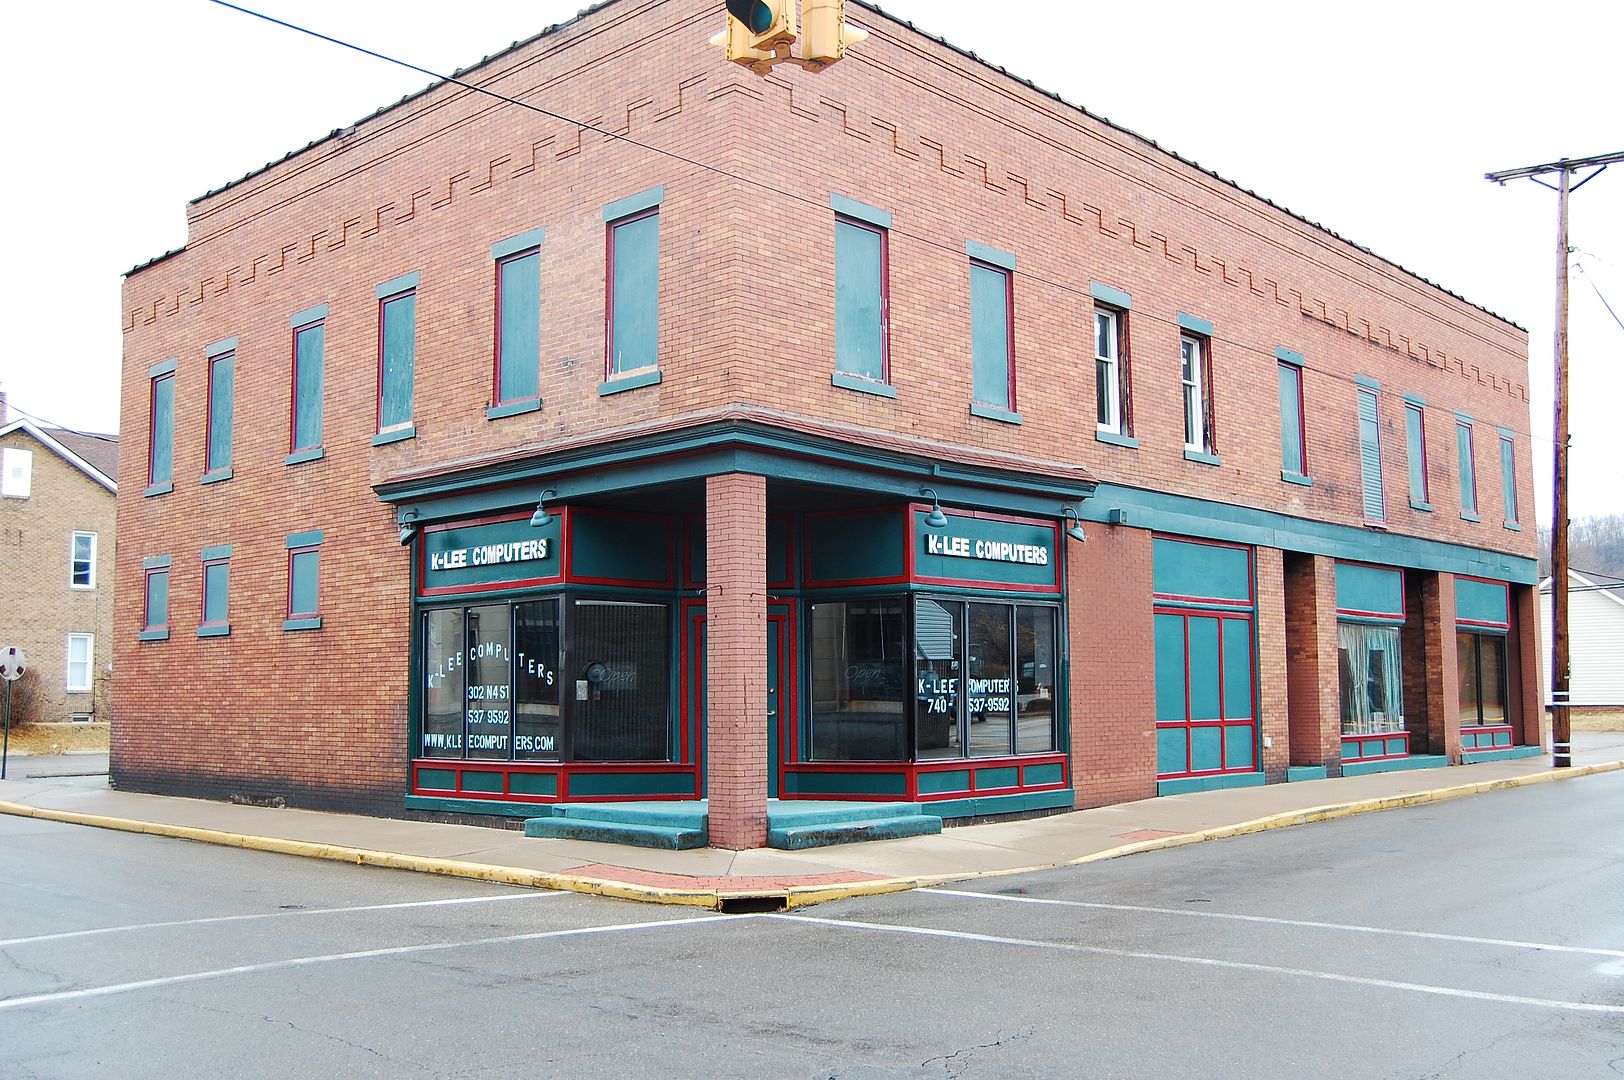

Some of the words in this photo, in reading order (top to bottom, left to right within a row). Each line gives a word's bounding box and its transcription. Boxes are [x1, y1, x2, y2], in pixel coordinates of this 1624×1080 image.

[431, 549, 467, 570] K-LEE
[472, 539, 547, 566] COMPUTERS
[928, 534, 970, 557] K-LEE
[976, 540, 1048, 565] COMPUTERS
[468, 686, 484, 700] 302
[918, 678, 956, 694] K-LEE
[468, 709, 484, 724] 537
[487, 710, 509, 724] 9592
